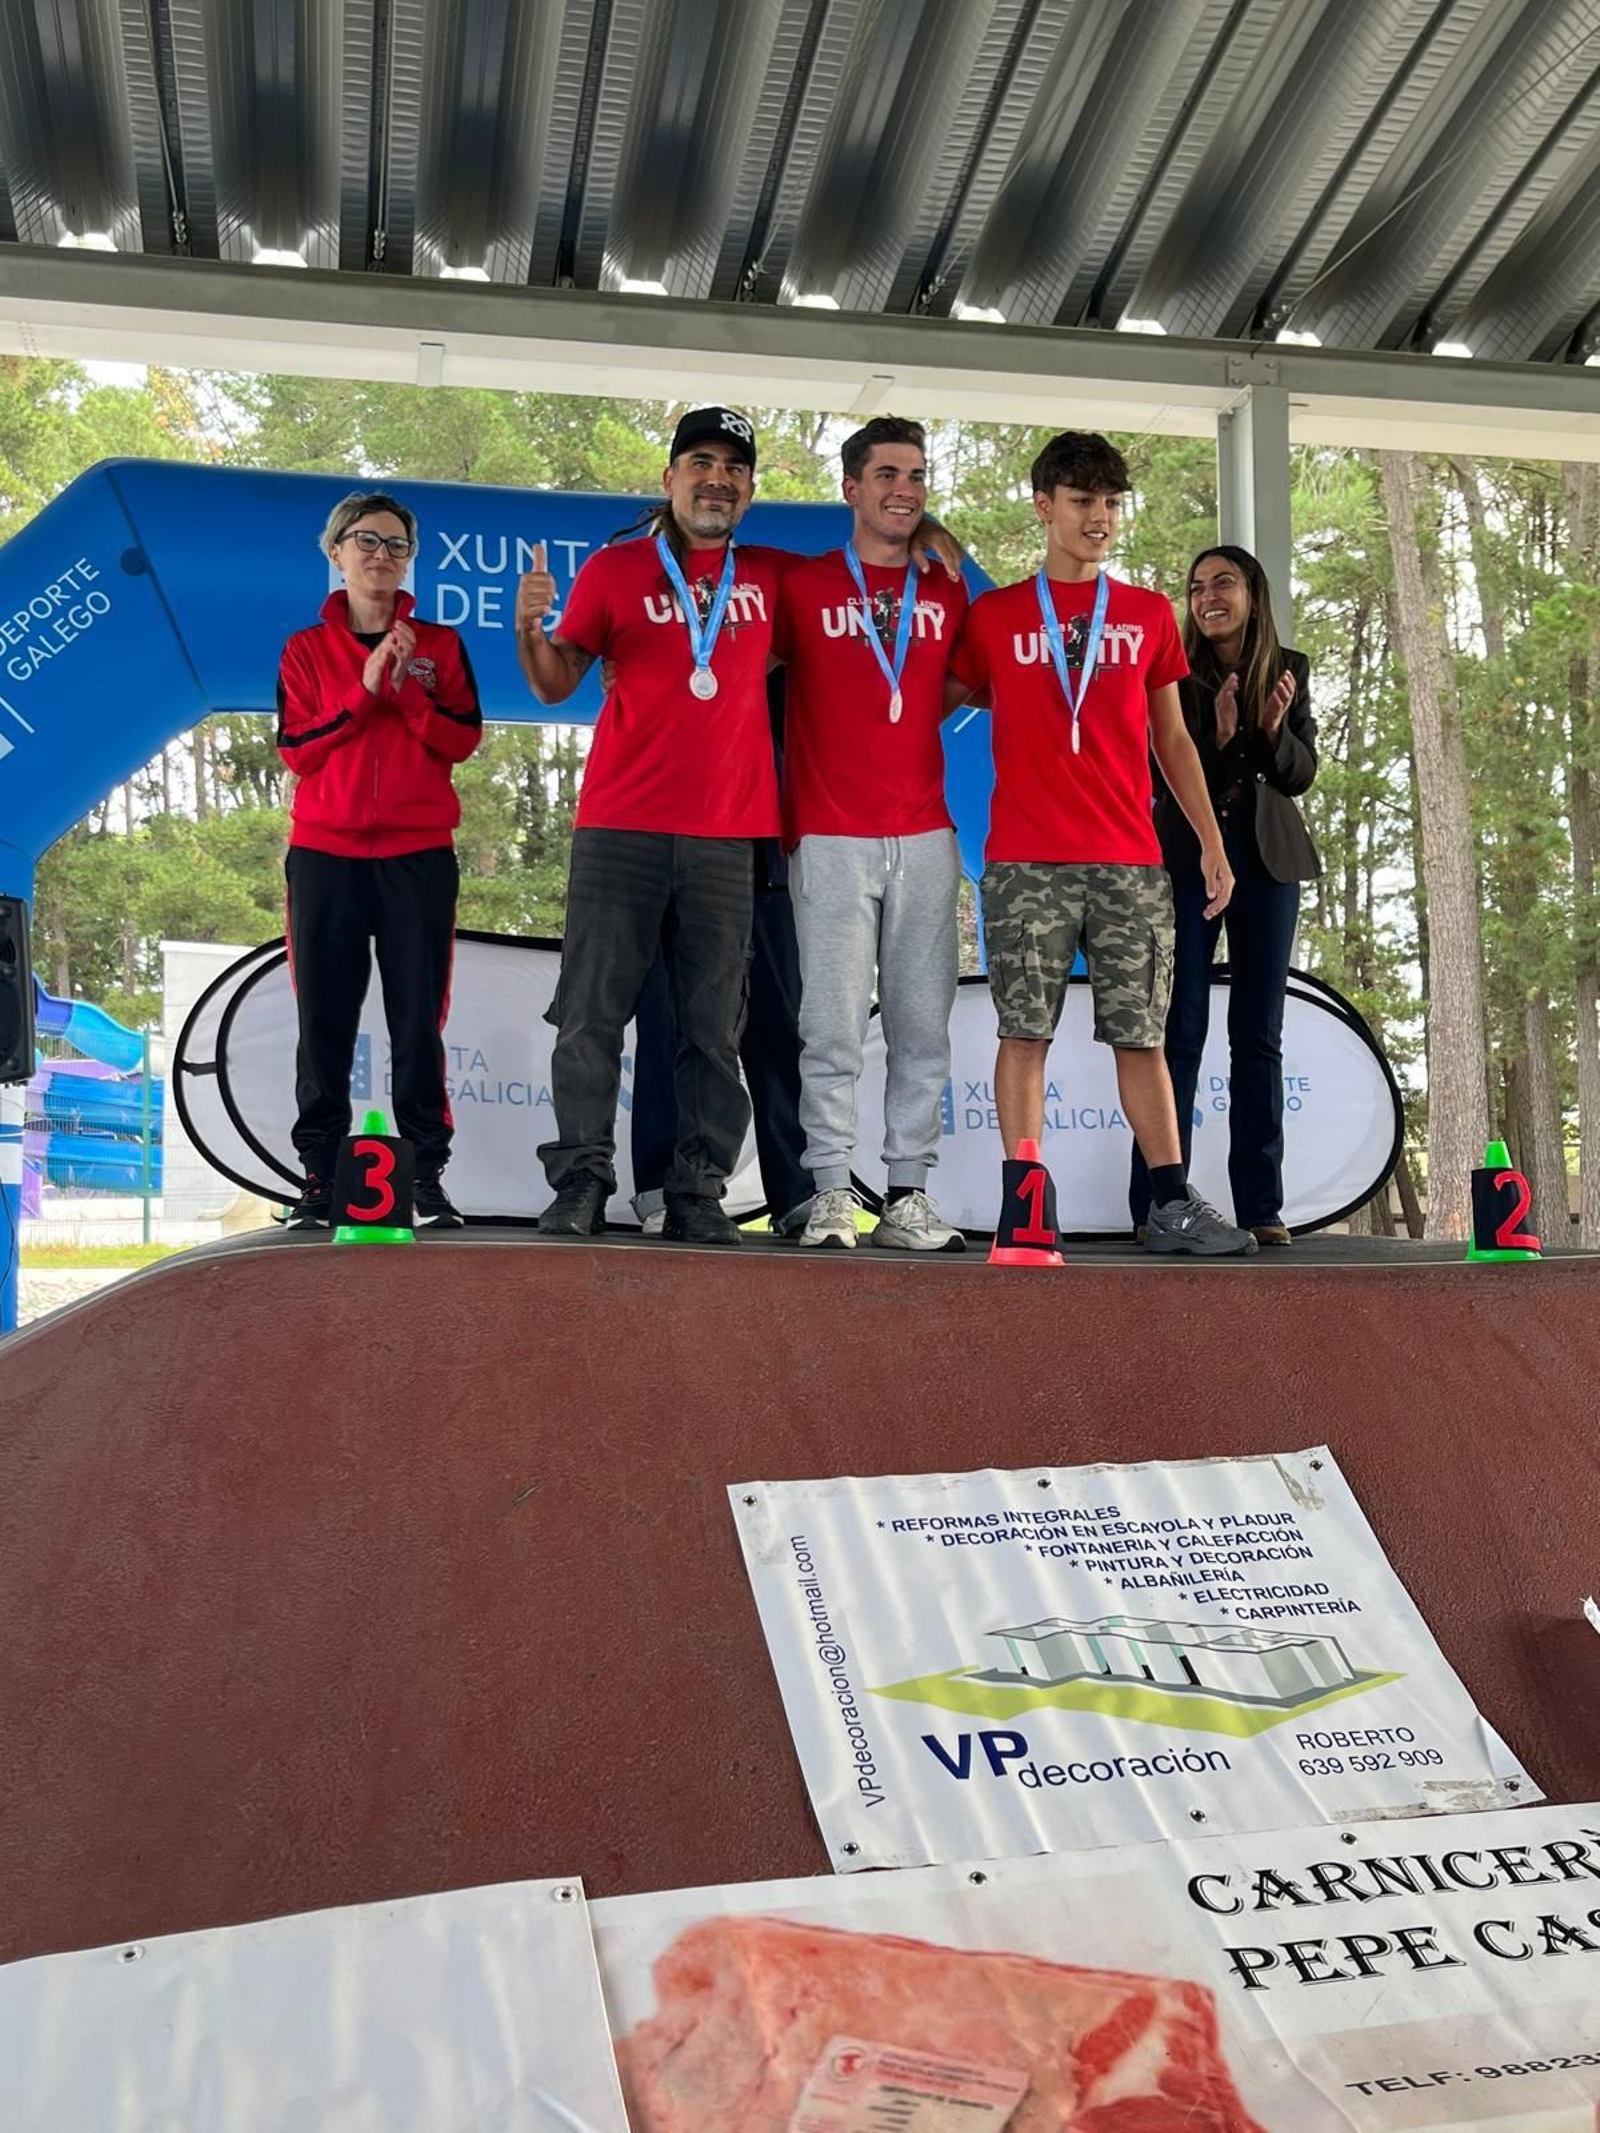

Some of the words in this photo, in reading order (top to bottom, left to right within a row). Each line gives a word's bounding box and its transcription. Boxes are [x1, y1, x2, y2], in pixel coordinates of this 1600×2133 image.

[438, 532, 608, 578] XUNT
[437, 584, 504, 628] DE
[822, 605, 945, 640] UNTY
[7, 591, 111, 681] GALEGO
[965, 1081, 1062, 1101] XUA
[1043, 1108, 1127, 1130] ALICIA
[347, 1140, 395, 1221] 3
[1013, 1169, 1055, 1244] 1
[1493, 1171, 1541, 1250] 2
[892, 1514, 1000, 1532] REFORMAS
[1003, 1506, 1121, 1524] INTEGRALES
[941, 1525, 1068, 1547] DECORACIÓN
[1072, 1524, 1098, 1537] EN
[1102, 1517, 1200, 1537] ESCAYOLA
[1202, 1517, 1215, 1530] Y
[1219, 1512, 1296, 1529] PLADUR
[1038, 1535, 1155, 1558] FONTANERIA
[1157, 1538, 1171, 1551] Y
[1176, 1528, 1304, 1549] CALEFACCIÓN
[1085, 1556, 1169, 1573] PINTURA
[1171, 1555, 1184, 1568] Y
[1189, 1544, 1314, 1566] DECORACIÓN
[1121, 1568, 1245, 1590] ALBAÑILERÍA
[1193, 1582, 1330, 1604] ELECTRICIDAD
[1235, 1597, 1361, 1620] CARPINTERÍA
[790, 1535, 886, 1808] VPdecoracion@hotmail.com
[1296, 1726, 1415, 1751] ROBERTO
[922, 1730, 1028, 1781] VP
[1017, 1746, 1231, 1790] decoración
[1300, 1757, 1343, 1777] 639
[1351, 1752, 1396, 1773] 592
[1400, 1748, 1444, 1769] 909
[1187, 1829, 1600, 1915] CARNICER
[1223, 1925, 1466, 1991] PEPE
[1474, 2052, 1600, 2078] 98823
